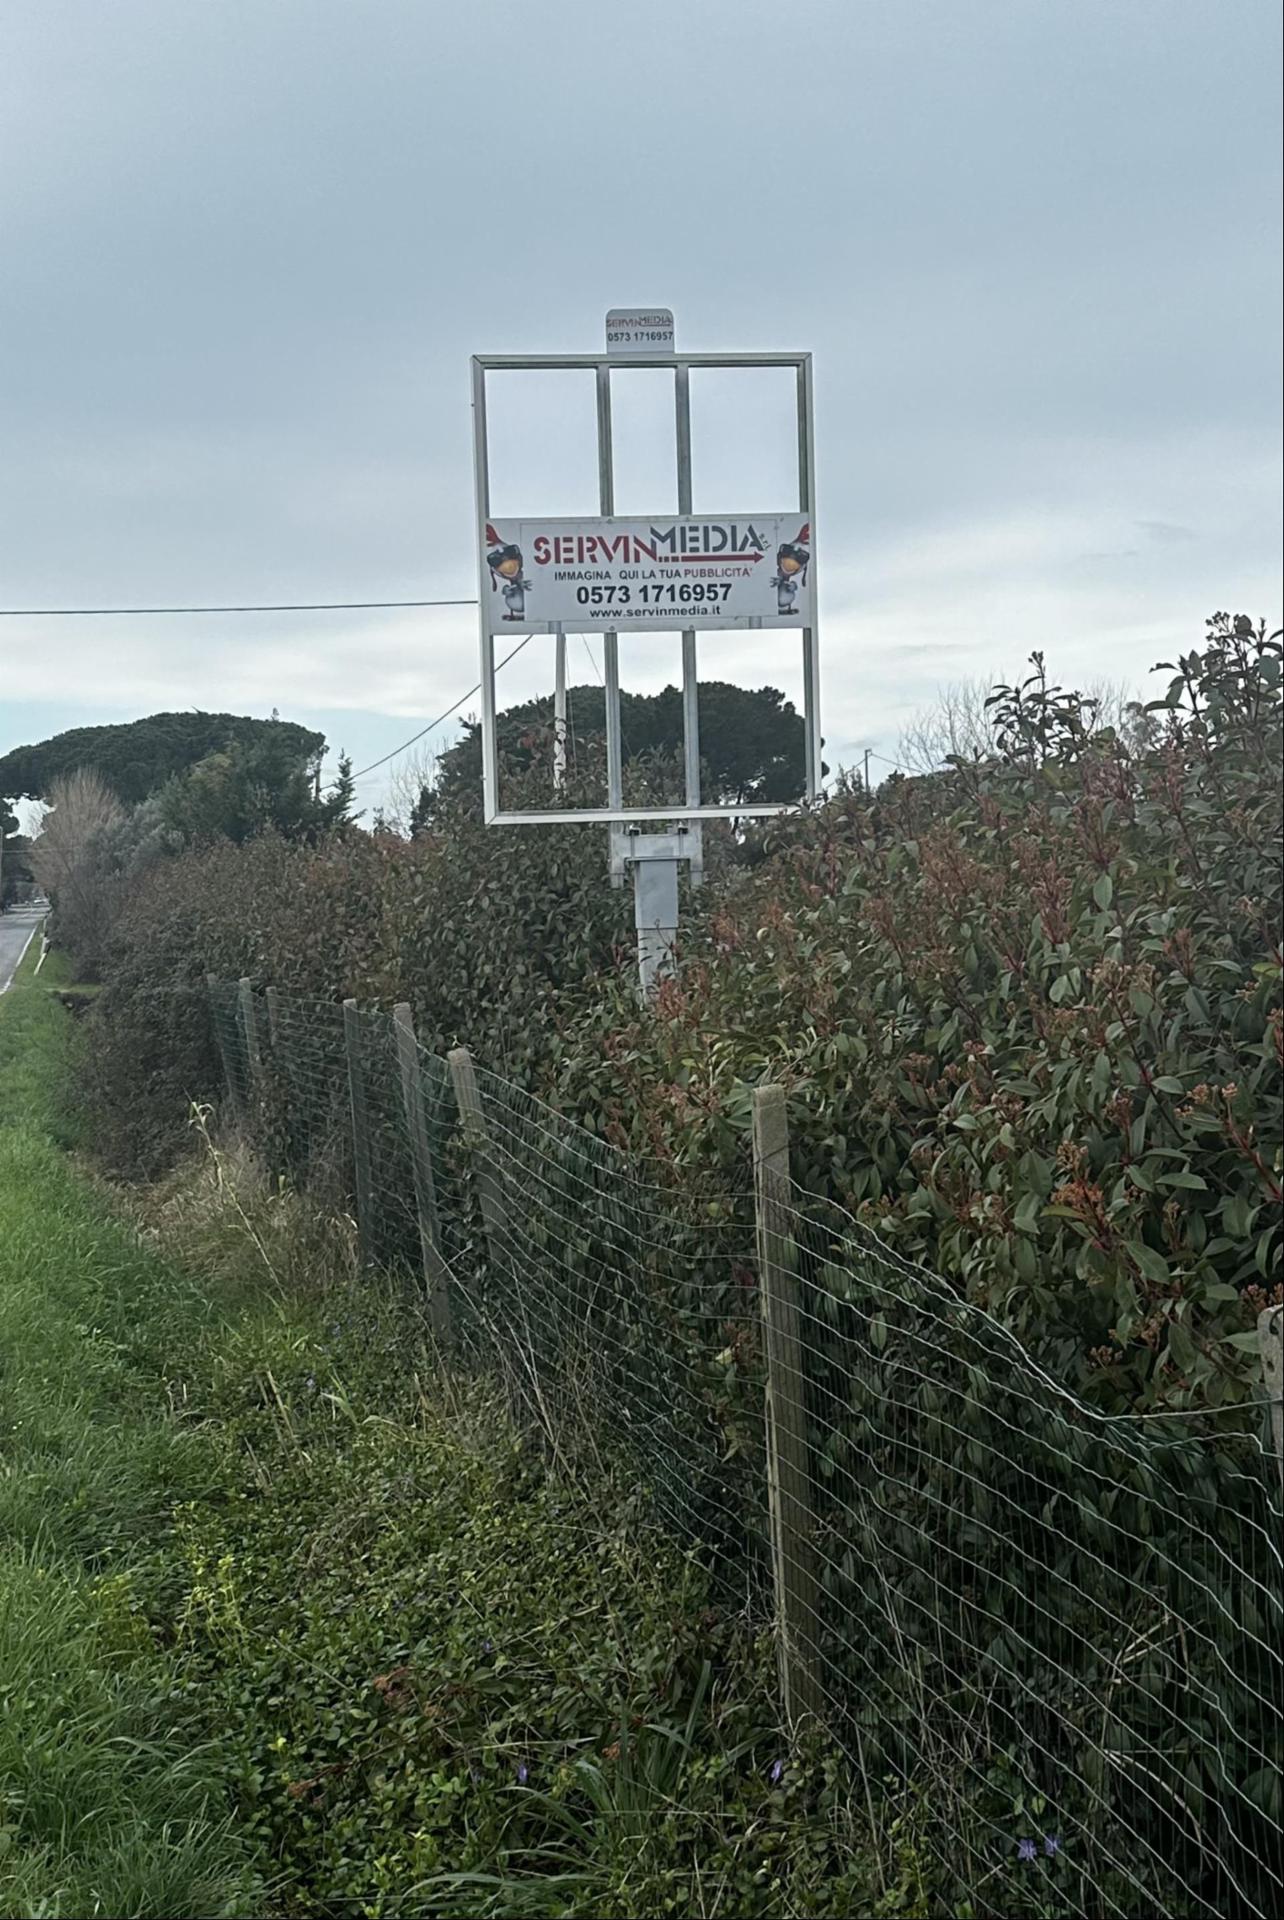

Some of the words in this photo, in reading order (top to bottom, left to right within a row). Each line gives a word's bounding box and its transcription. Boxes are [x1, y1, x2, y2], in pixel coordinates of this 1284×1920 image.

[607, 332, 631, 342] 0573
[634, 331, 673, 342] 1716957
[554, 570, 612, 581] IMMAGINA
[619, 570, 639, 580] QUI
[642, 570, 656, 580] LA
[659, 569, 681, 579] TUA
[576, 585, 631, 604] 0573
[638, 583, 733, 603] 1716957
[589, 605, 721, 618] www.servinmedia.it
